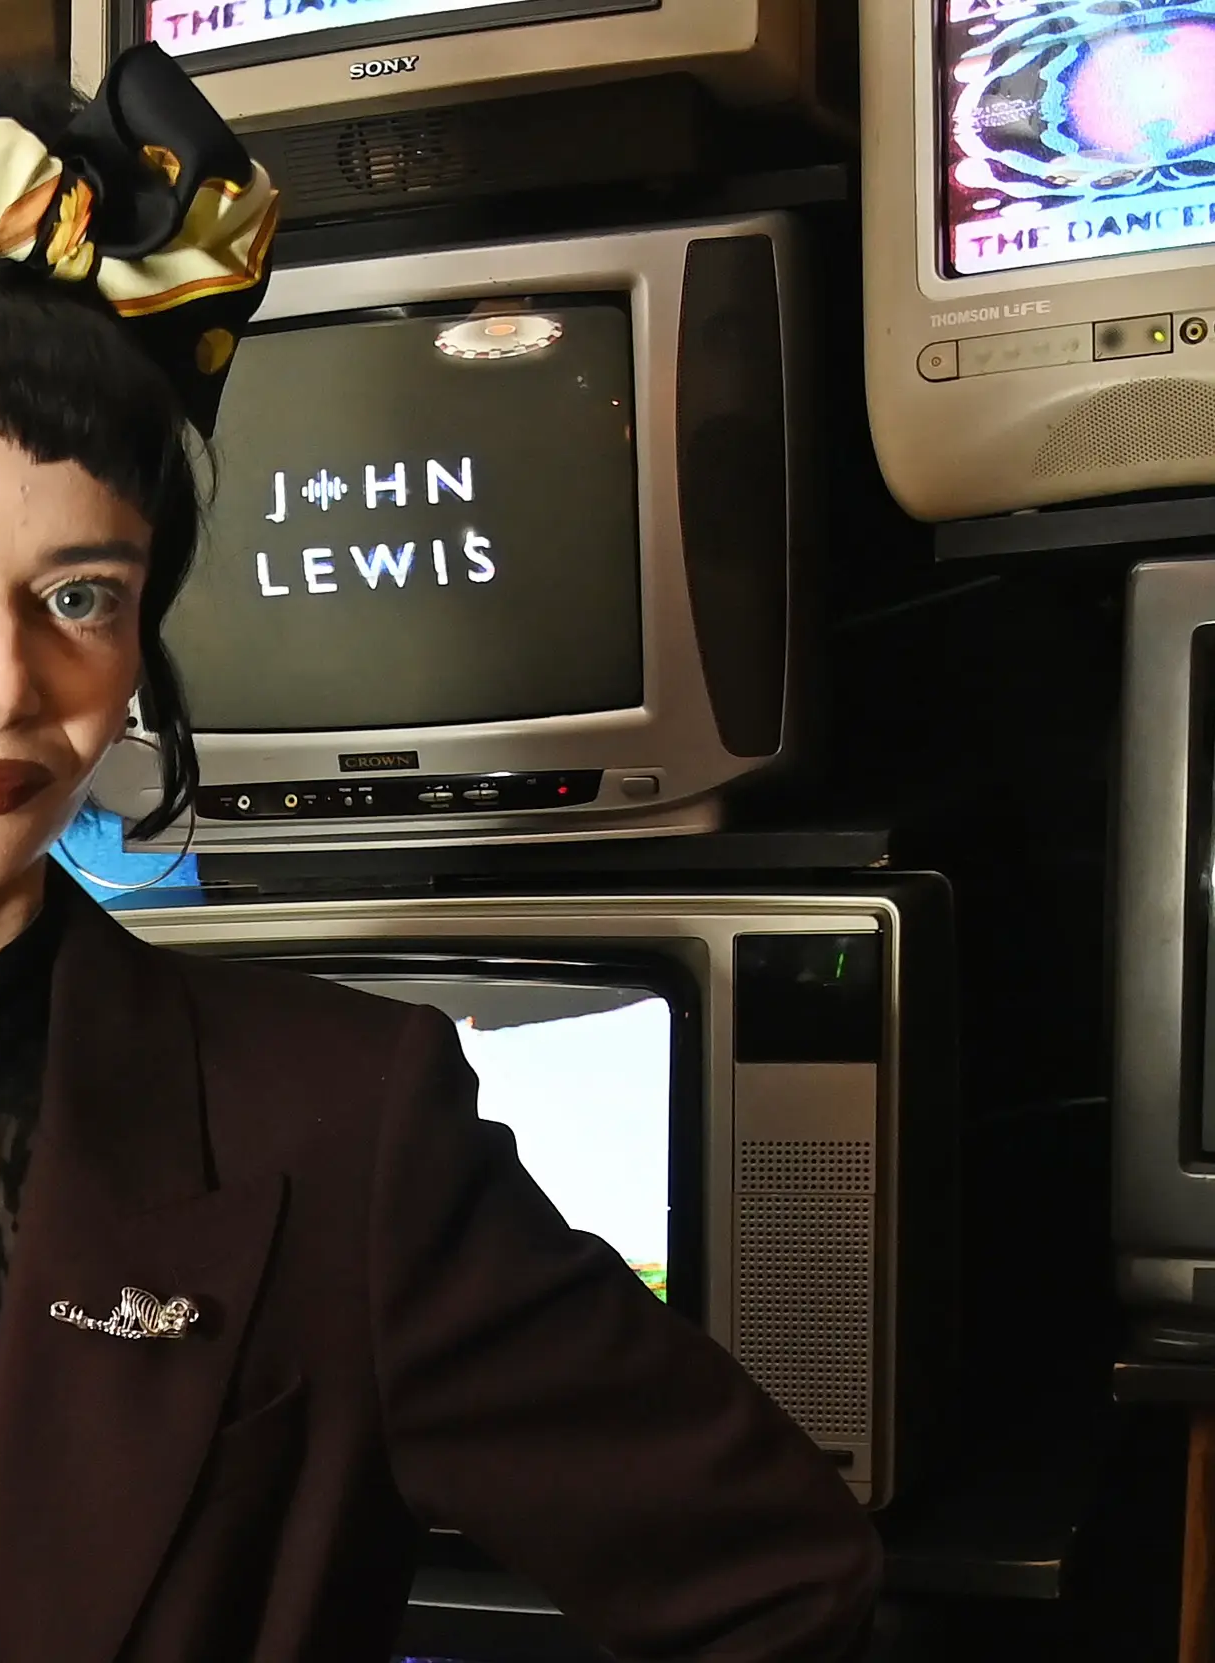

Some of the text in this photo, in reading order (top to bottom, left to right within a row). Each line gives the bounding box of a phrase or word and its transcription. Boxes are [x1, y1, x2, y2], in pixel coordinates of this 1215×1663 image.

[163, 1, 246, 39] THE
[348, 55, 420, 80] SONY
[970, 225, 1051, 258] THE
[929, 305, 1000, 328] THOMSON
[256, 532, 497, 597] LEWIS
[344, 756, 410, 769] CROWN
